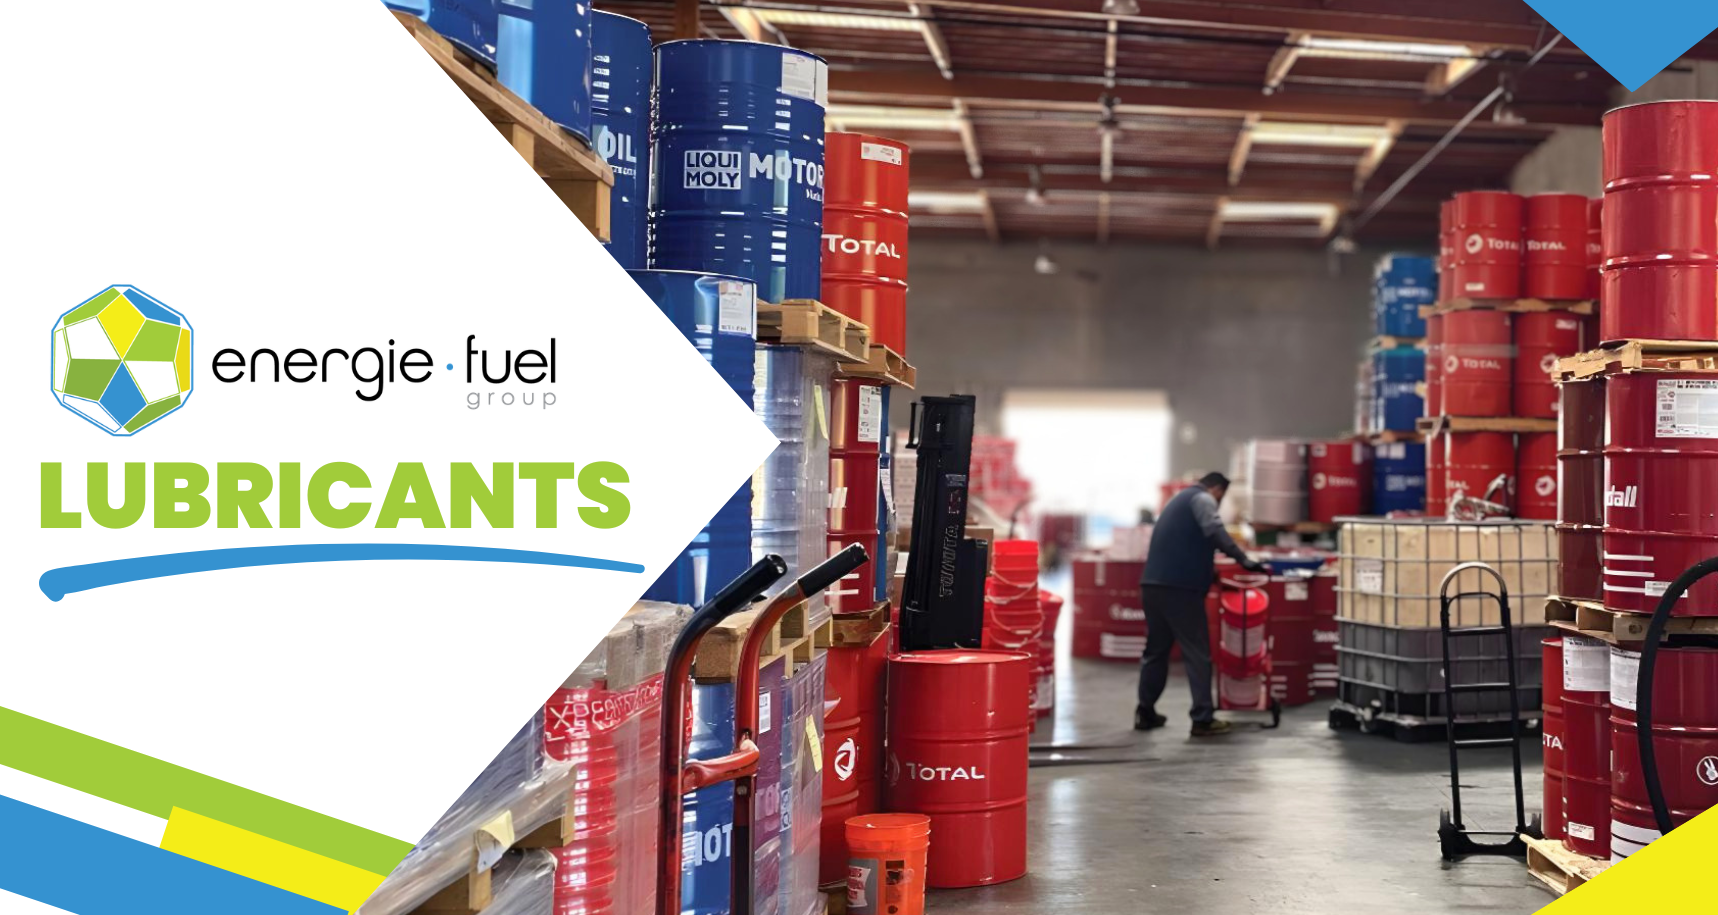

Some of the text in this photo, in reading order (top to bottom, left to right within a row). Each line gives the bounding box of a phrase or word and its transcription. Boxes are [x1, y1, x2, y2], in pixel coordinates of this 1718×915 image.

[597, 125, 637, 163] OIL
[687, 152, 738, 169] LIQUI
[686, 171, 739, 188] MOLY
[821, 233, 900, 259] TOTAL
[1527, 240, 1566, 251] TOTAL
[1462, 358, 1501, 369] TOTAL
[906, 762, 985, 781] TOTAL
